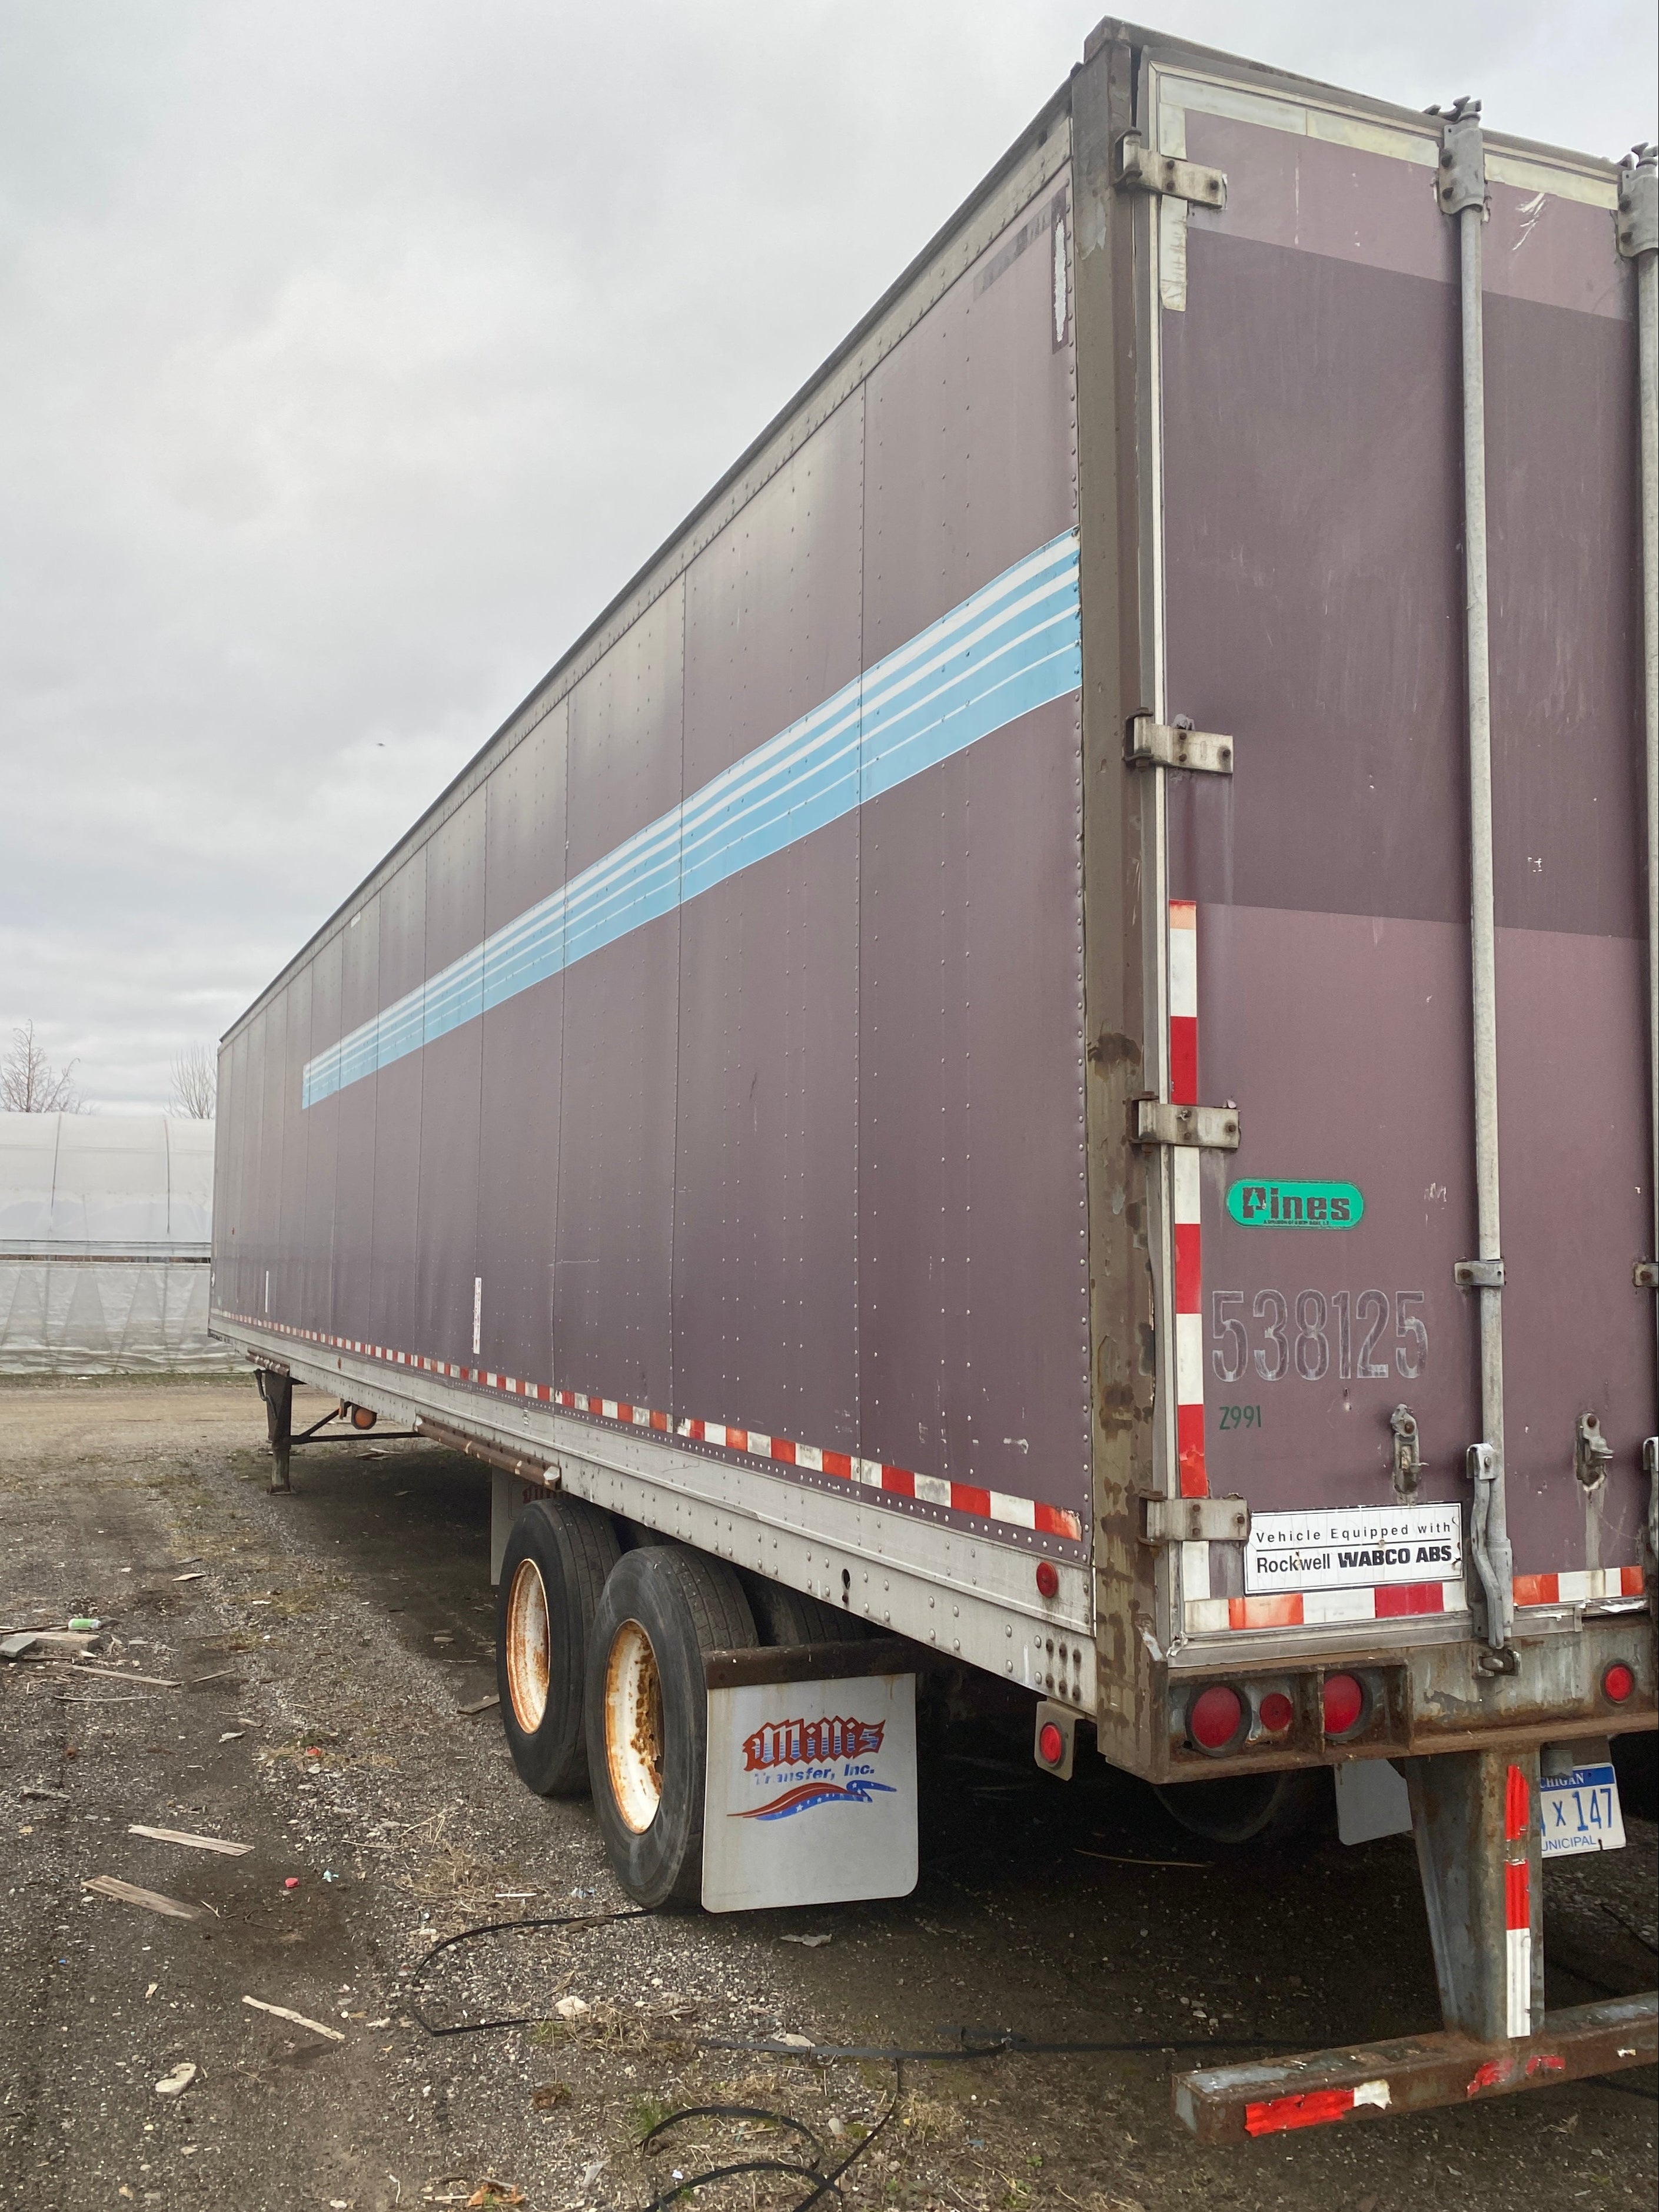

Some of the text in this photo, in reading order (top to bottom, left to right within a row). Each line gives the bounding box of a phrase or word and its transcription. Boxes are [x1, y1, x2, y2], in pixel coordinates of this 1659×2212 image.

[1242, 1187, 1350, 1221] Pines
[1212, 1288, 1428, 1382] 538125
[1256, 1522, 1451, 1543] Vehicle Equipped with
[1257, 1545, 1452, 1573] Rockwell WABCO ABS
[743, 1716, 885, 1770] Millis
[843, 1763, 875, 1776] Inc.
[1540, 1772, 1584, 1788] CHIGAN
[1541, 1835, 1597, 1852] UNICIPAL
